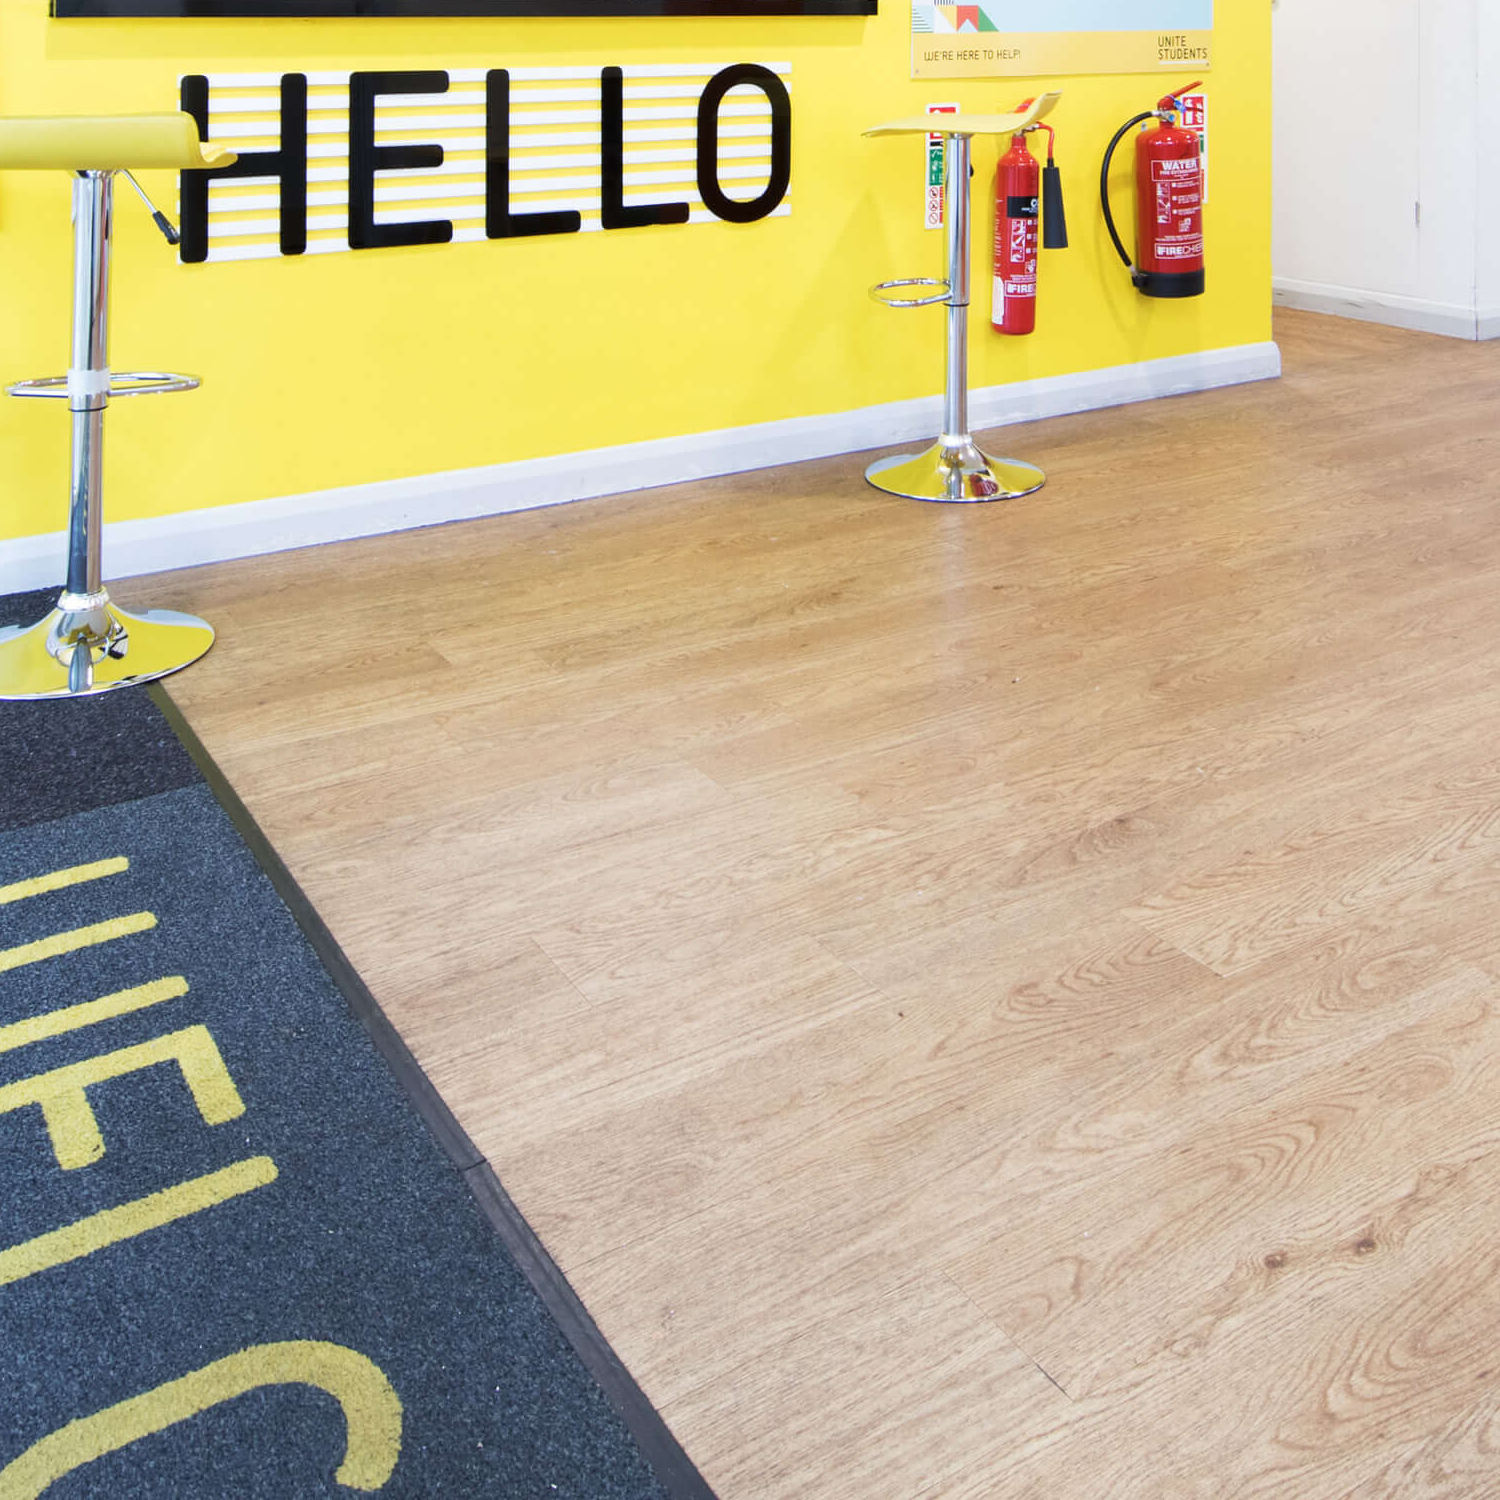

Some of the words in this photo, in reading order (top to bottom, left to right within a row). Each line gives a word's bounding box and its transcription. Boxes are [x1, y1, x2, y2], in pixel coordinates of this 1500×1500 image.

[1157, 35, 1186, 47] UNITE
[923, 50, 954, 62] WE'RE
[956, 50, 980, 61] HERE
[982, 49, 994, 60] TO
[996, 49, 1021, 60] HELP!
[1157, 47, 1208, 61] STUDENTS
[180, 62, 791, 263] HELLO
[1161, 159, 1198, 170] WATER
